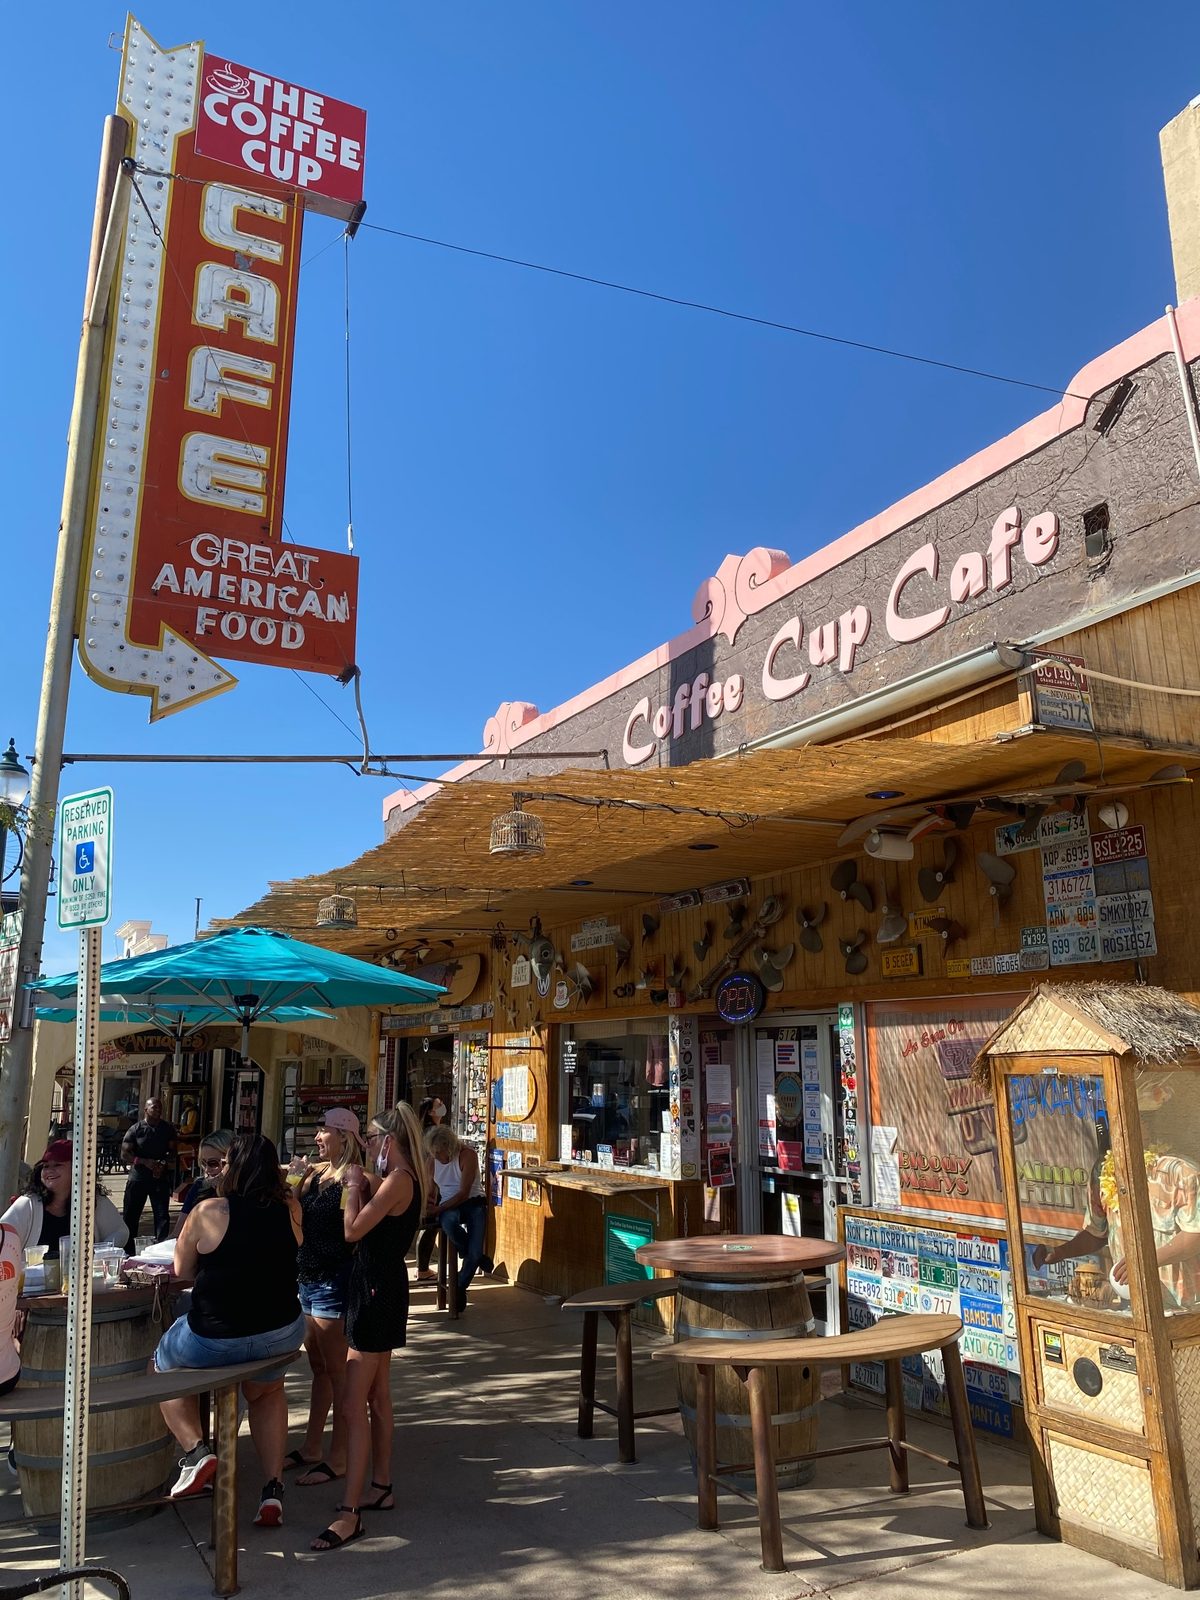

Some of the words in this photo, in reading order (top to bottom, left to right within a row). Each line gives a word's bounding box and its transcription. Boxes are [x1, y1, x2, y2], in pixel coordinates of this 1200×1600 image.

[248, 72, 324, 126] THE
[203, 92, 361, 171] COFFEE
[241, 139, 322, 187] CUP
[178, 181, 288, 518] CAFE
[190, 533, 319, 583] GREAT
[151, 563, 350, 623] AMERICAN
[195, 606, 306, 649] FOOD
[622, 672, 745, 766] Coffee
[762, 604, 871, 702] Cup
[885, 506, 1060, 644] Cafe
[1050, 690, 1076, 700] NEVADA
[1041, 708, 1063, 716] VEHICLE
[64, 799, 108, 823] RESERVED
[66, 820, 104, 843] PARKING
[1041, 820, 1060, 837] KHS
[1066, 815, 1085, 833] 734
[1043, 850, 1059, 868] AQP
[1066, 845, 1089, 863] 6935
[72, 875, 96, 894] ONLY
[1048, 875, 1091, 896] 31A672Z
[1110, 894, 1137, 902] NEVADA
[1051, 938, 1070, 955] 699
[1078, 935, 1096, 953] 624
[892, 952, 914, 969] SEGER
[717, 984, 757, 1013] OPEN
[779, 1029, 796, 1041] 512
[902, 1039, 919, 1058] As
[920, 1028, 946, 1048] Seen
[947, 1018, 965, 1035] On
[1010, 1077, 1039, 1126] BIG
[1039, 1077, 1109, 1130] KAHUNA
[897, 1150, 973, 1175] Bloody
[899, 1171, 970, 1196] Marys
[847, 1224, 861, 1241] NON
[864, 1228, 878, 1246] FAT
[880, 1230, 916, 1250] DSRRATT
[933, 1240, 955, 1258] 5173
[976, 1244, 997, 1263] 3441
[860, 1254, 878, 1272] 1109
[897, 1262, 914, 1278] 4191
[921, 1264, 936, 1281] EKF
[941, 1268, 956, 1286] 380
[959, 1274, 971, 1290] 22
[976, 1277, 999, 1296] SCHI
[849, 1278, 863, 1296] FEE
[866, 1283, 881, 1300] 892
[934, 1296, 952, 1315] 717
[964, 1336, 982, 1354] AYD
[988, 1341, 1006, 1361] 672
[966, 1367, 983, 1387] 57K
[988, 1374, 1007, 1393] 855
